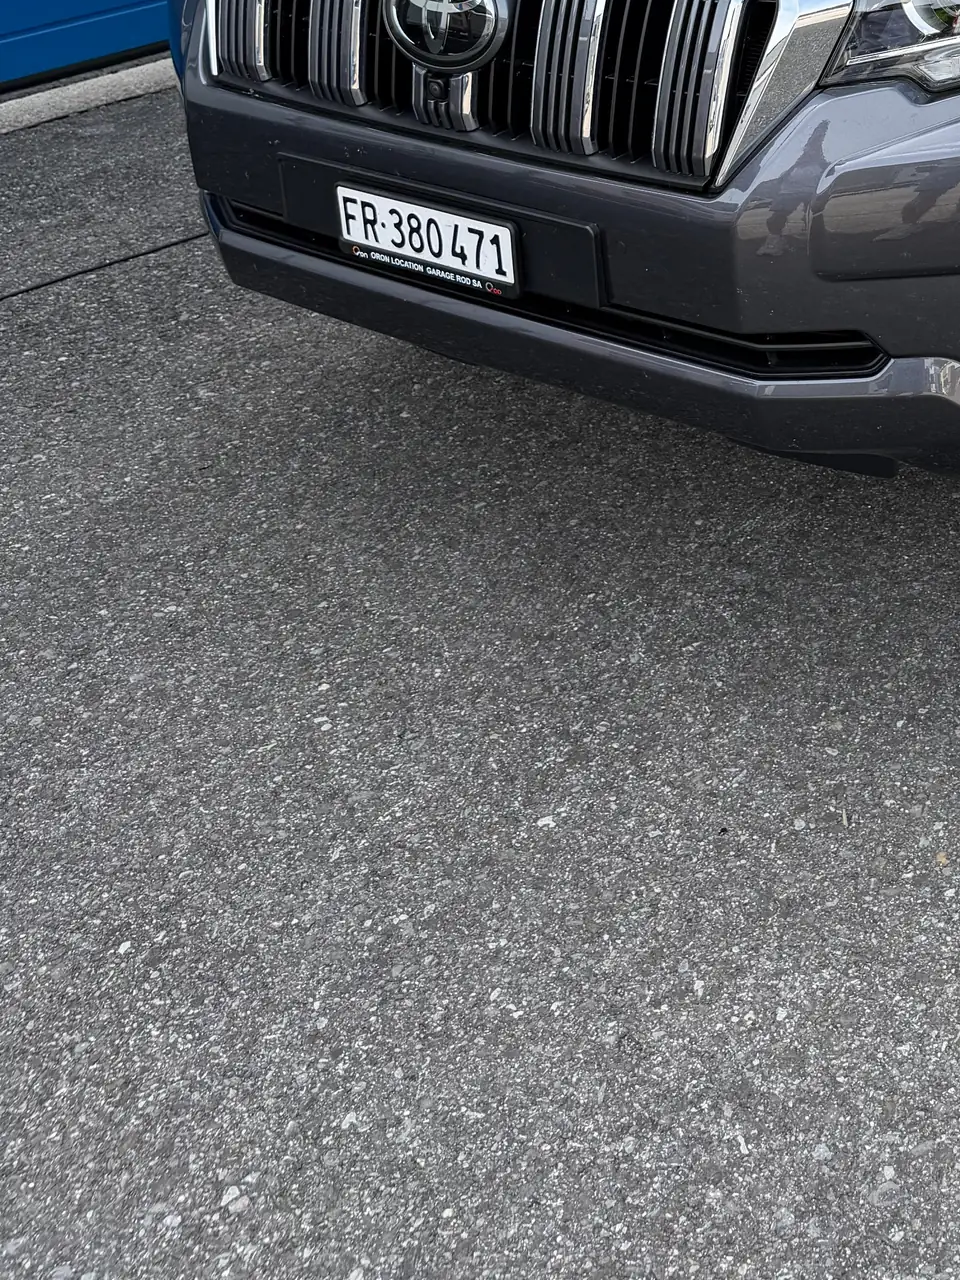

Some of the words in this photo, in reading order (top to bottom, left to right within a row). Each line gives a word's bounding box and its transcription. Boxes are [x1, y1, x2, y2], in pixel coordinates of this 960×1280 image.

[370, 251, 390, 263] ORON
[391, 256, 424, 273] LOCATION
[426, 266, 456, 281] GARAGE
[456, 274, 471, 286] ROD
[472, 279, 483, 289] SA
